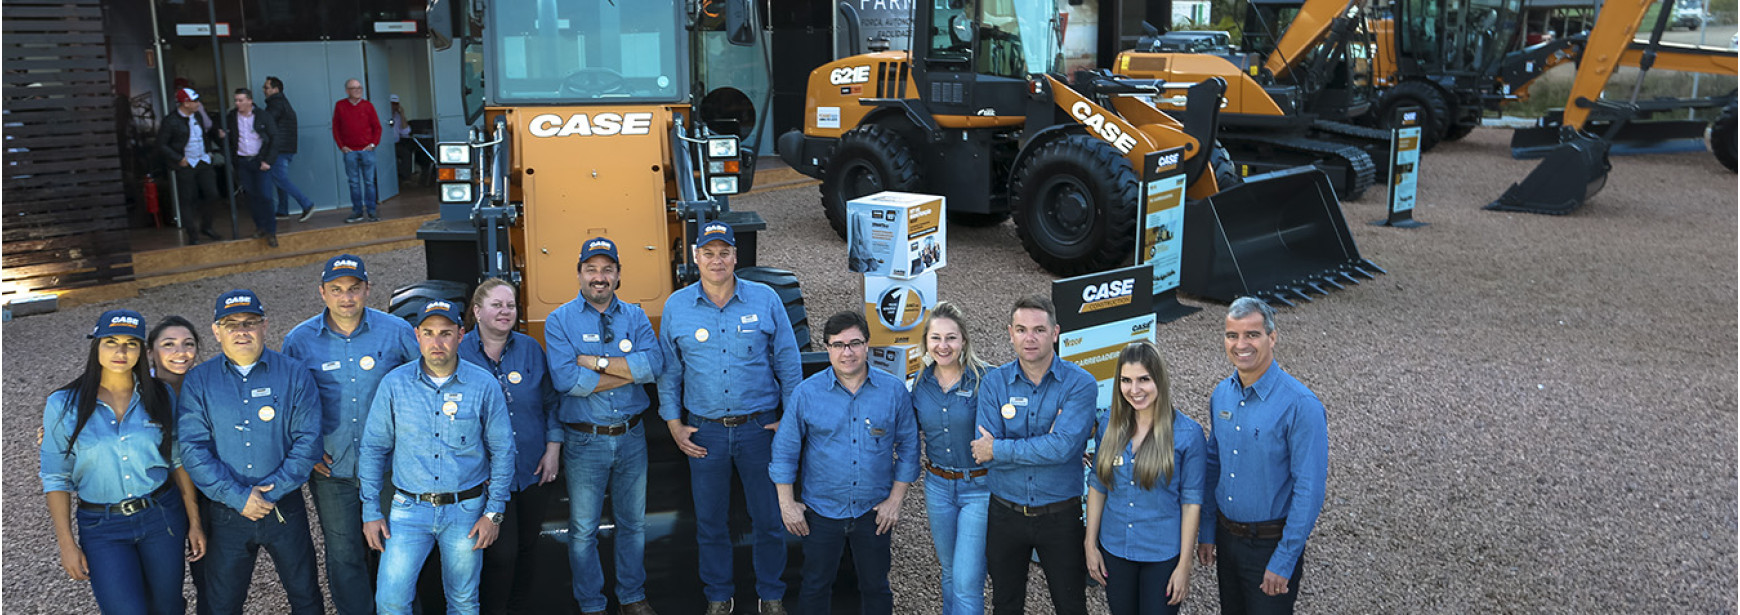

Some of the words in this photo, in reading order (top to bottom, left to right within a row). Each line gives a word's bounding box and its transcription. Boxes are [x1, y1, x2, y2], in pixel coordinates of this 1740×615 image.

[830, 65, 870, 85] 621E
[529, 112, 653, 138] CASE
[1072, 101, 1138, 154] CASE
[1158, 153, 1179, 166] CASE
[589, 240, 611, 249] CASE
[333, 259, 358, 268] CASE
[1082, 279, 1135, 302] CASE
[225, 296, 252, 305] CASE
[426, 301, 450, 309] CASE
[1089, 297, 1130, 309] CONSTRUCTION
[111, 316, 139, 326] CASE
[1131, 322, 1151, 332] CASE
[1074, 350, 1121, 367] CARREGADEIR
